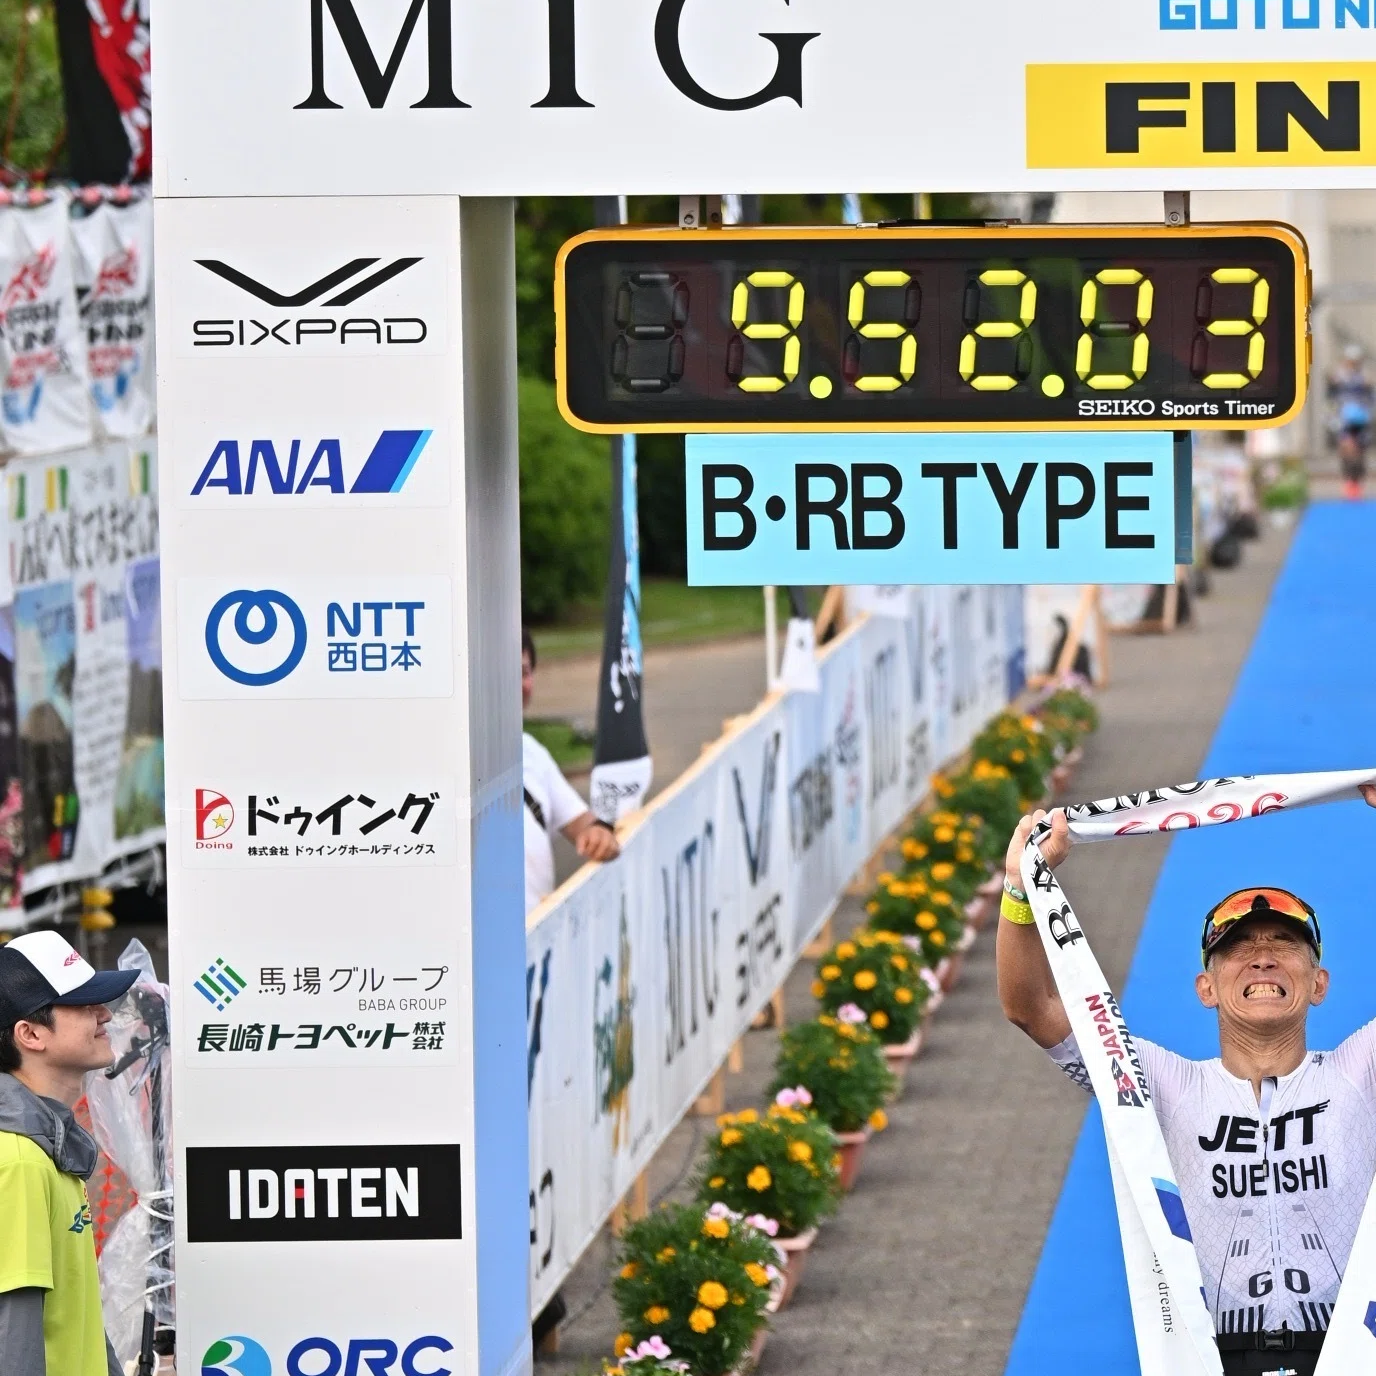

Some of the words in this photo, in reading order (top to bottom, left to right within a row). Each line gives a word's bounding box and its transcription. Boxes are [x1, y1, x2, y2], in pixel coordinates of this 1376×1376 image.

[192, 317, 428, 347] SIXPAD
[730, 268, 1270, 399] 9.52.03
[1078, 399, 1156, 416] SEIKO
[1161, 400, 1219, 418] Sports
[1224, 400, 1276, 415] Timer
[189, 438, 346, 496] ANA
[920, 461, 1156, 550] TYPE
[326, 601, 426, 638] NTT
[327, 640, 422, 673] 西日本
[247, 791, 441, 837] ドゥイング
[195, 841, 233, 850] Doing
[247, 845, 290, 857] 株式会社
[295, 843, 436, 857] ドゥイングホールディングス
[258, 965, 449, 996] 馬場グループ
[358, 998, 396, 1012] BABA
[399, 998, 447, 1011] GROUP
[196, 1022, 410, 1053] 長崎トヨペット
[1084, 994, 1124, 1061] JAPAN
[1198, 1099, 1331, 1153] JETT
[228, 1167, 419, 1220] IDATEN
[1157, 1281, 1174, 1333] dreams
